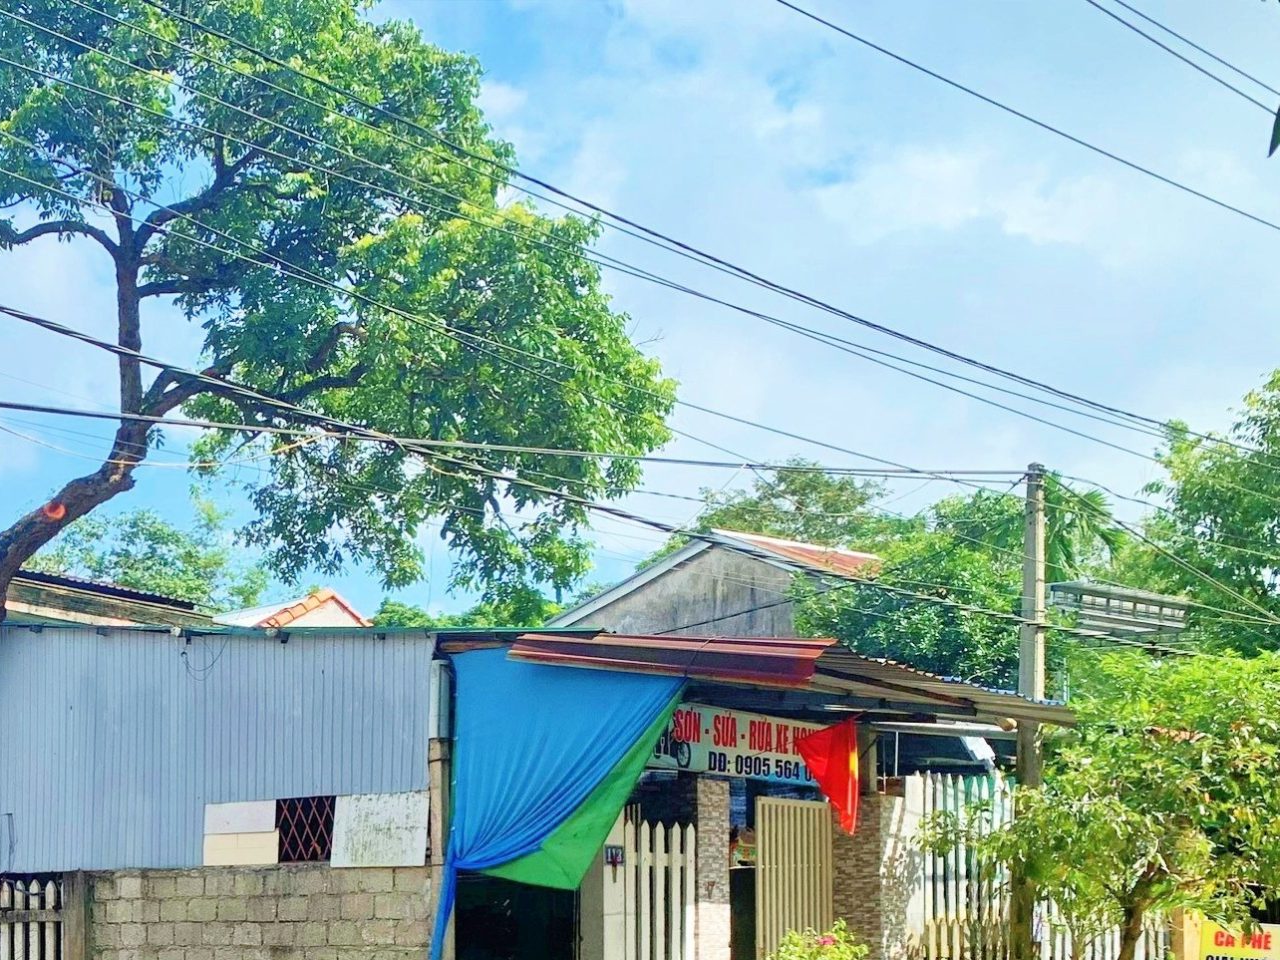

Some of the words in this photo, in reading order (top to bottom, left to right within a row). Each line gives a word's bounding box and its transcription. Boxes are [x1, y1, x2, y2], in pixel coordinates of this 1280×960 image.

[776, 724, 789, 754] XE
[735, 755, 770, 777] 0905
[775, 759, 800, 780] 564
